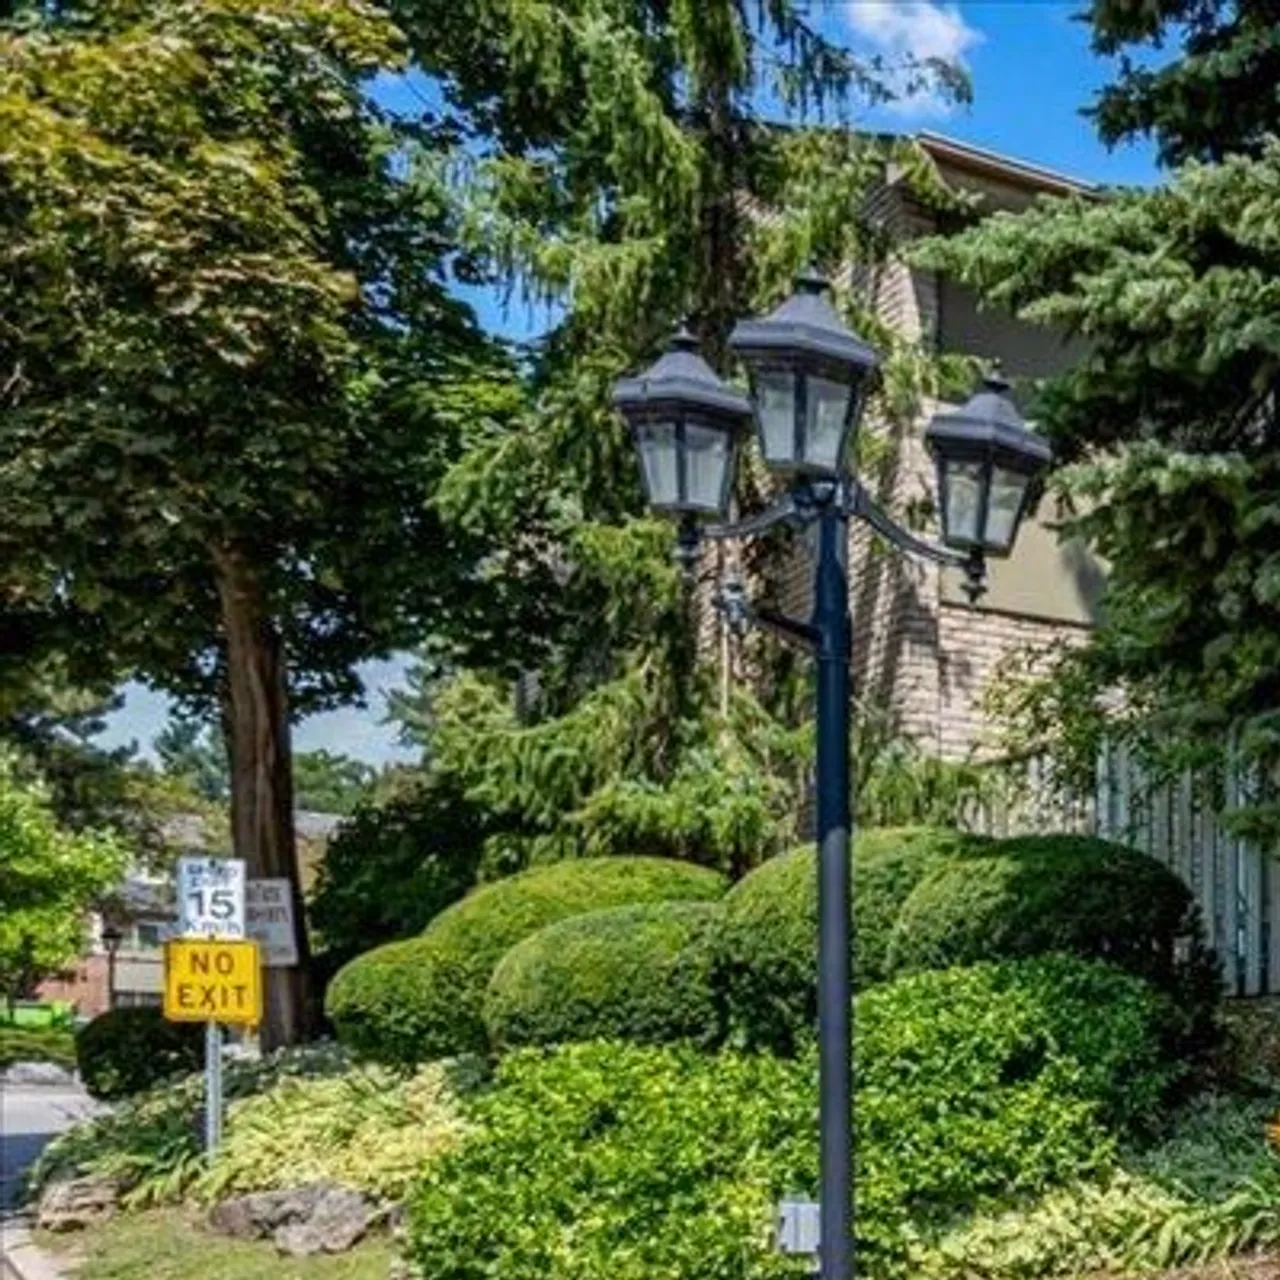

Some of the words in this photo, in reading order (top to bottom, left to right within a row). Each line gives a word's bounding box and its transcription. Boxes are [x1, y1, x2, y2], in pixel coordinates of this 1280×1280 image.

[187, 889, 235, 919] 15
[190, 951, 234, 974] NO
[177, 984, 246, 1010] EXIT
